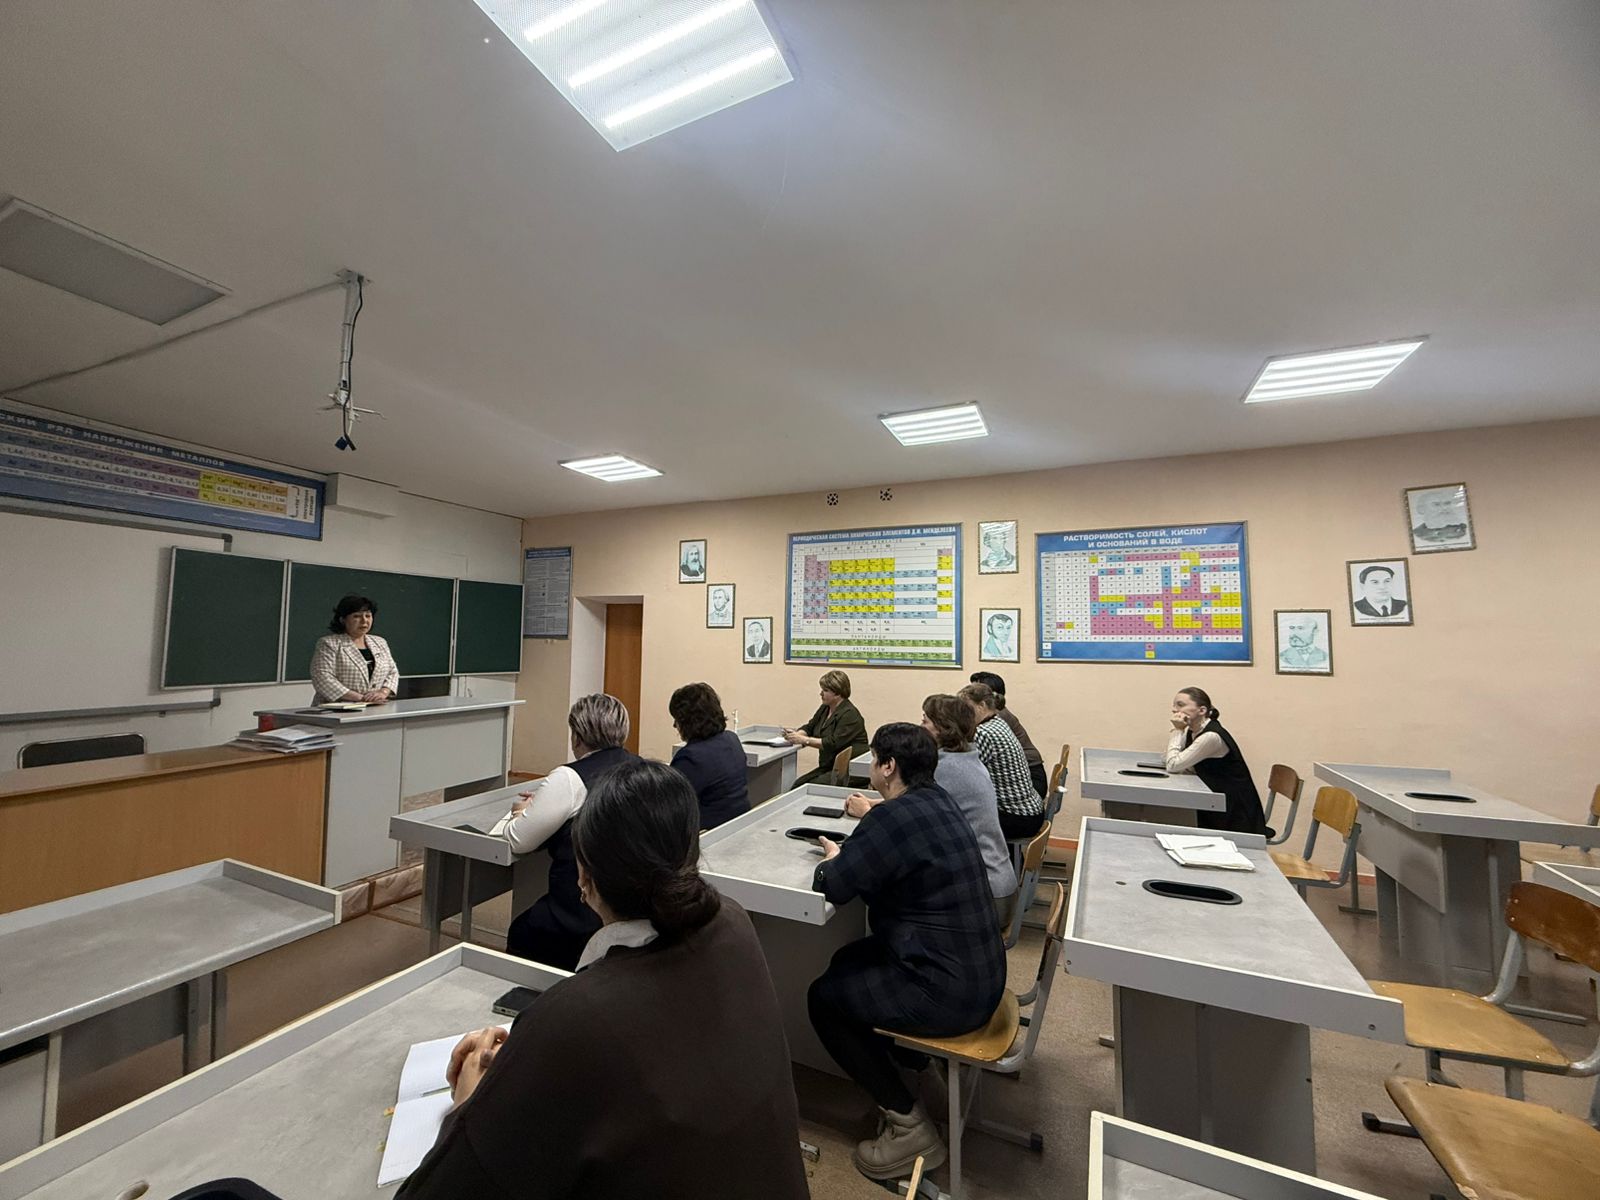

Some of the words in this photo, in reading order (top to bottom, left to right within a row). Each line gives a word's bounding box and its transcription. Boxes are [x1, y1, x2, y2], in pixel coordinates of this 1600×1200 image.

[47, 423, 73, 435] РЯД
[83, 431, 163, 454] НАПРЯЖЕНИЯ
[171, 450, 225, 467] МЕТАЛЛОВ
[1063, 532, 1135, 542] РАСТВОРИМОСТЬ
[1171, 527, 1208, 536] КИСЛОТ
[1096, 537, 1149, 548] ОСНОВАНИЙ
[1159, 537, 1183, 546] ВОДЕ
